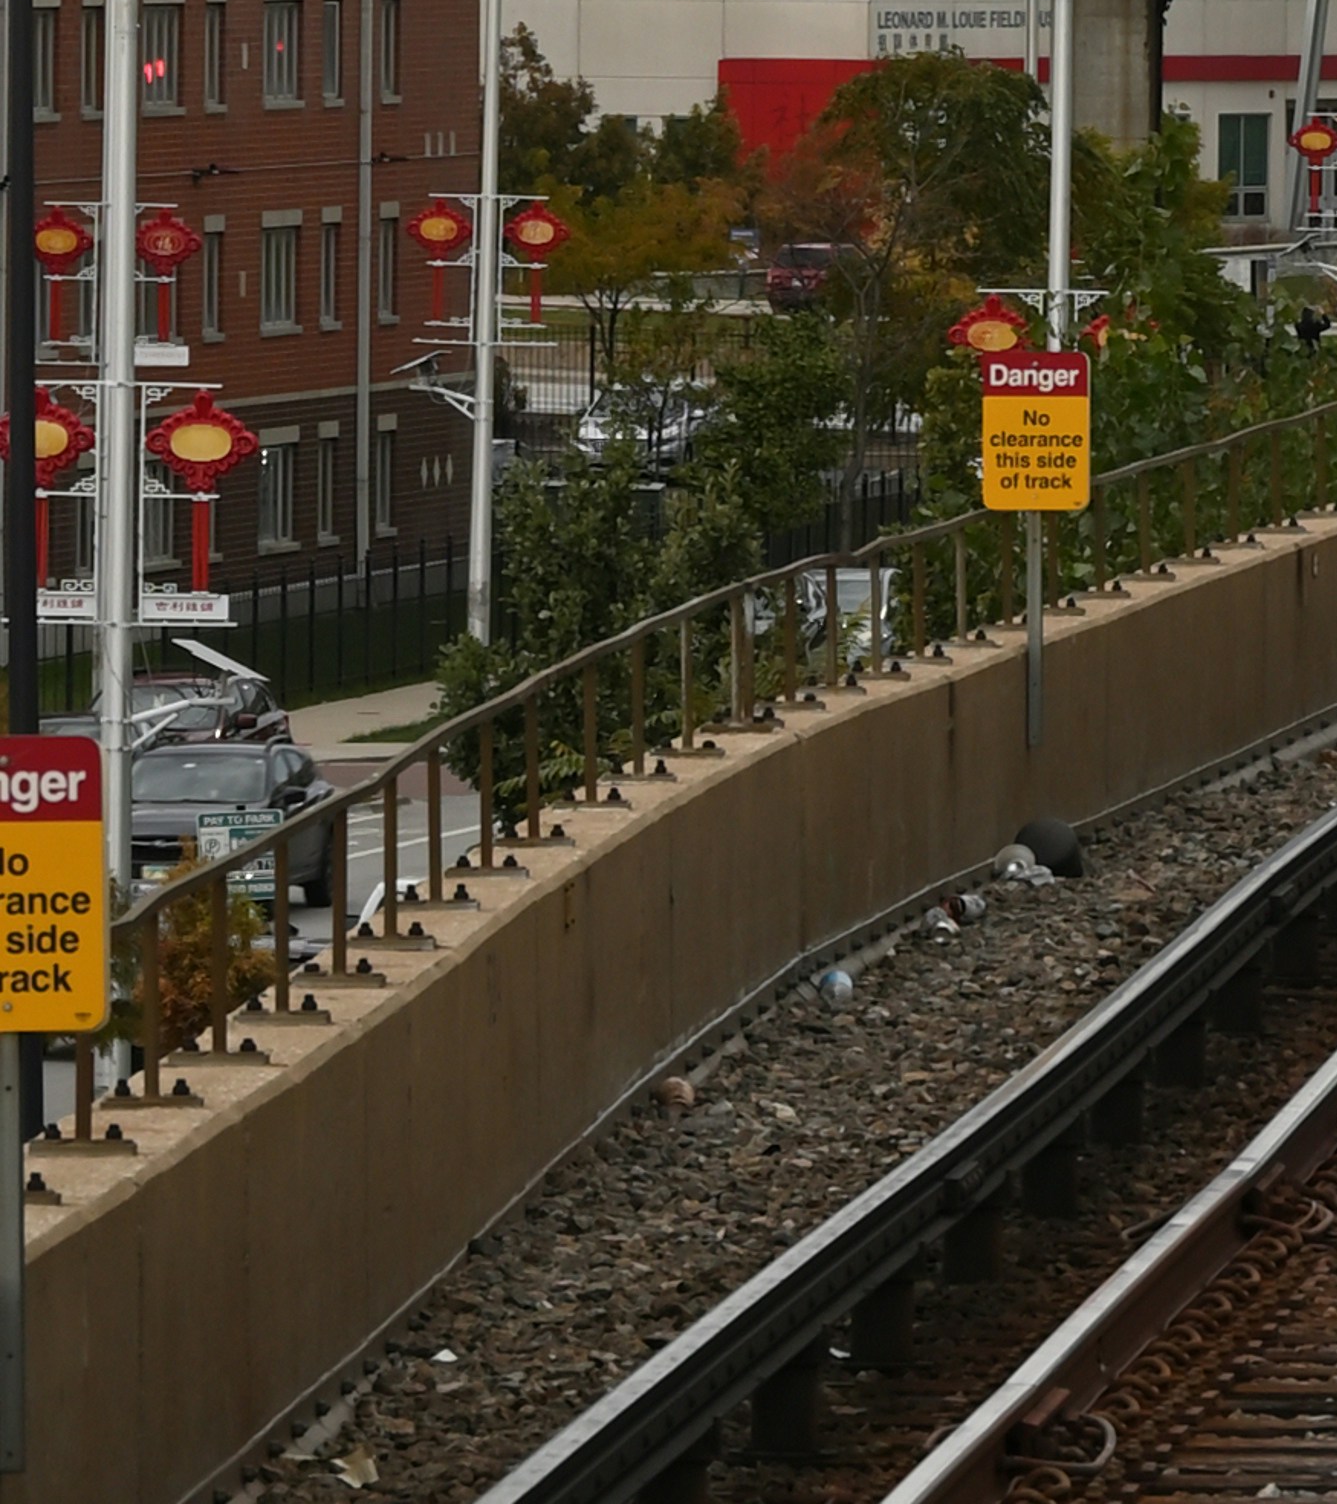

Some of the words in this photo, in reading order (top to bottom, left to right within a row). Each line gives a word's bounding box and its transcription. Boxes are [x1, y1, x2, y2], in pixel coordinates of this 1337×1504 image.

[877, 11, 934, 29] LEONARD
[936, 11, 948, 29] M.
[952, 11, 986, 29] LOUIE
[989, 363, 1080, 392] Danger
[1023, 410, 1050, 426] No
[989, 431, 1084, 448] clearance
[996, 452, 1031, 469] this
[1036, 452, 1077, 469] side
[1000, 473, 1019, 489] of
[1025, 473, 1072, 489] track
[203, 817, 225, 825] PAY
[227, 815, 243, 824] TO
[245, 813, 275, 824] PARK
[0, 848, 29, 876] o
[5, 925, 79, 954] side
